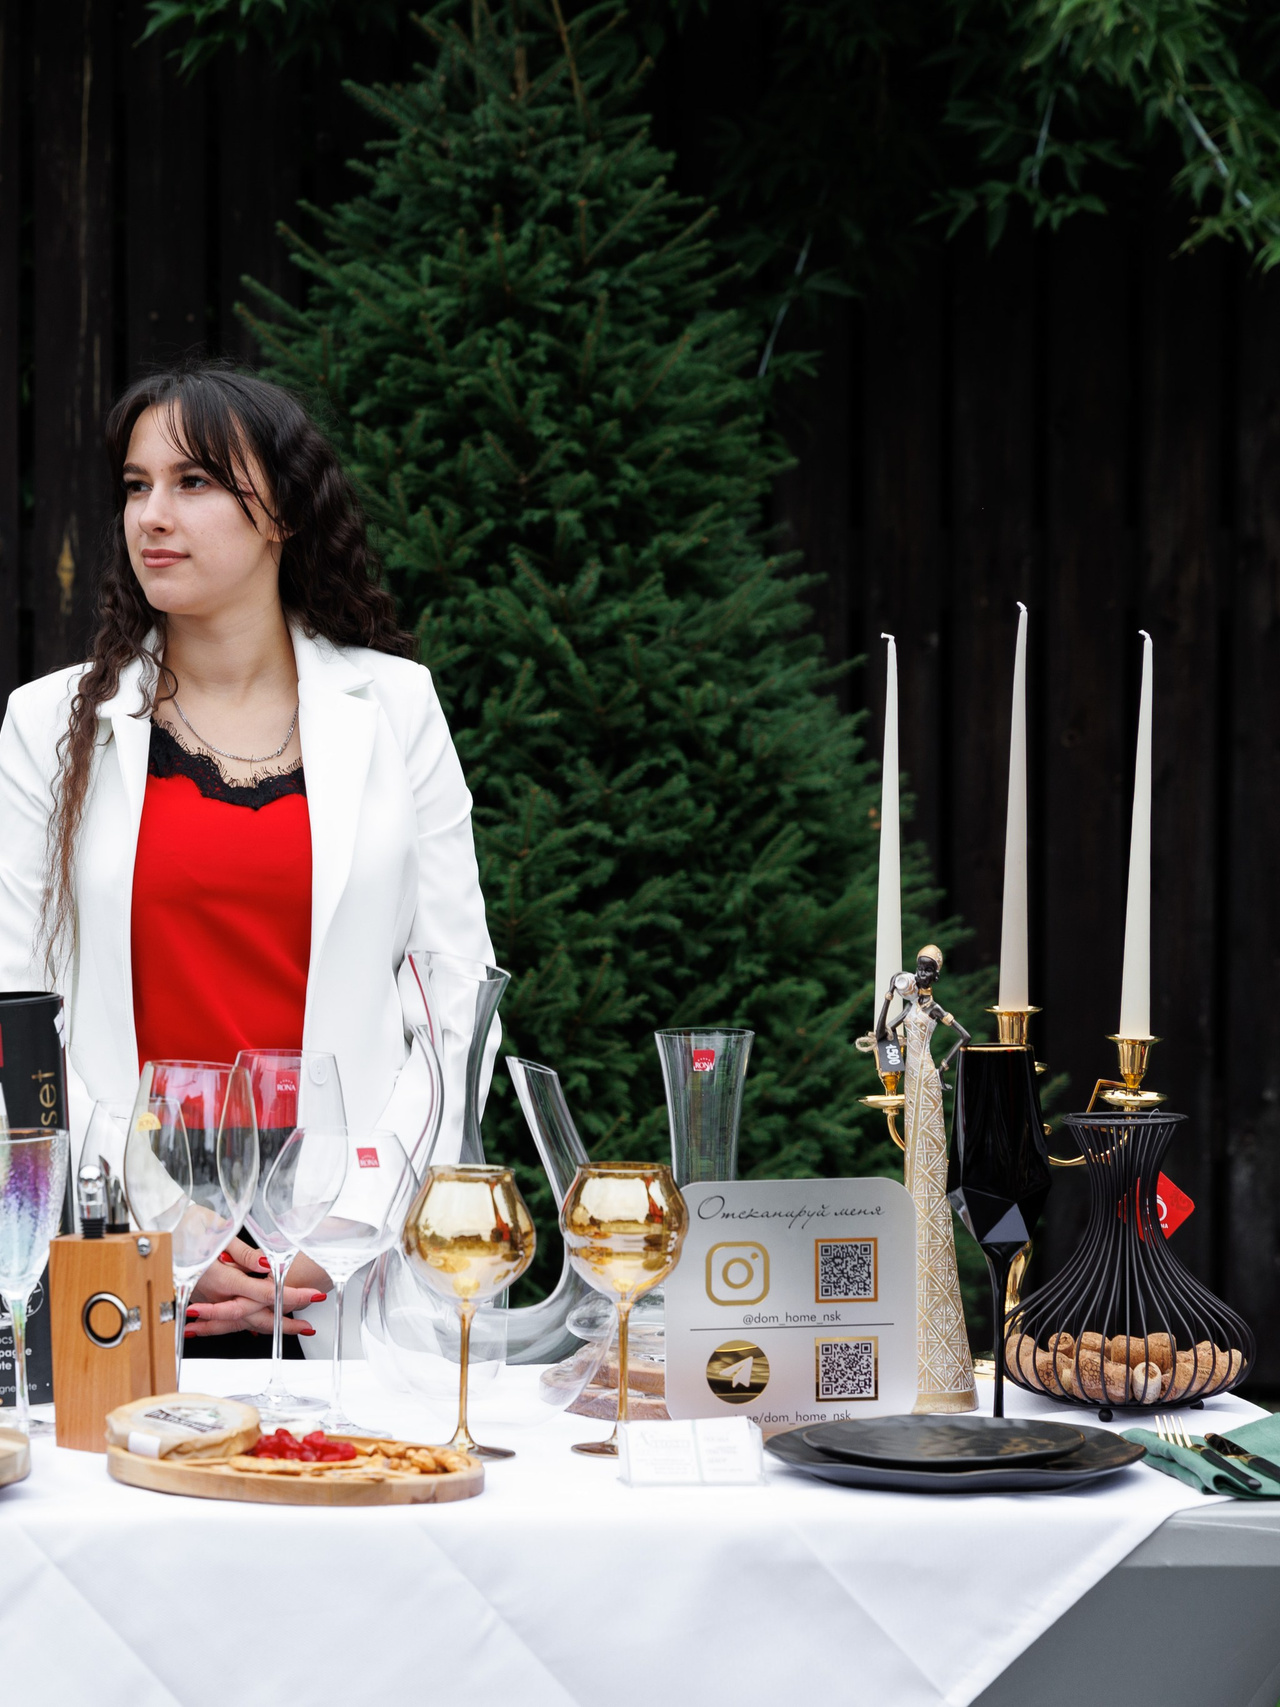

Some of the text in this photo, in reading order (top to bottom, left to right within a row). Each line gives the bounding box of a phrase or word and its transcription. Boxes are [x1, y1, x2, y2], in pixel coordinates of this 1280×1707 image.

[31, 1069, 58, 1127] set
[276, 1083, 297, 1092] RONA
[697, 1194, 885, 1230] Отсканируй меня
[742, 1311, 842, 1326] @dom_home_nsk
